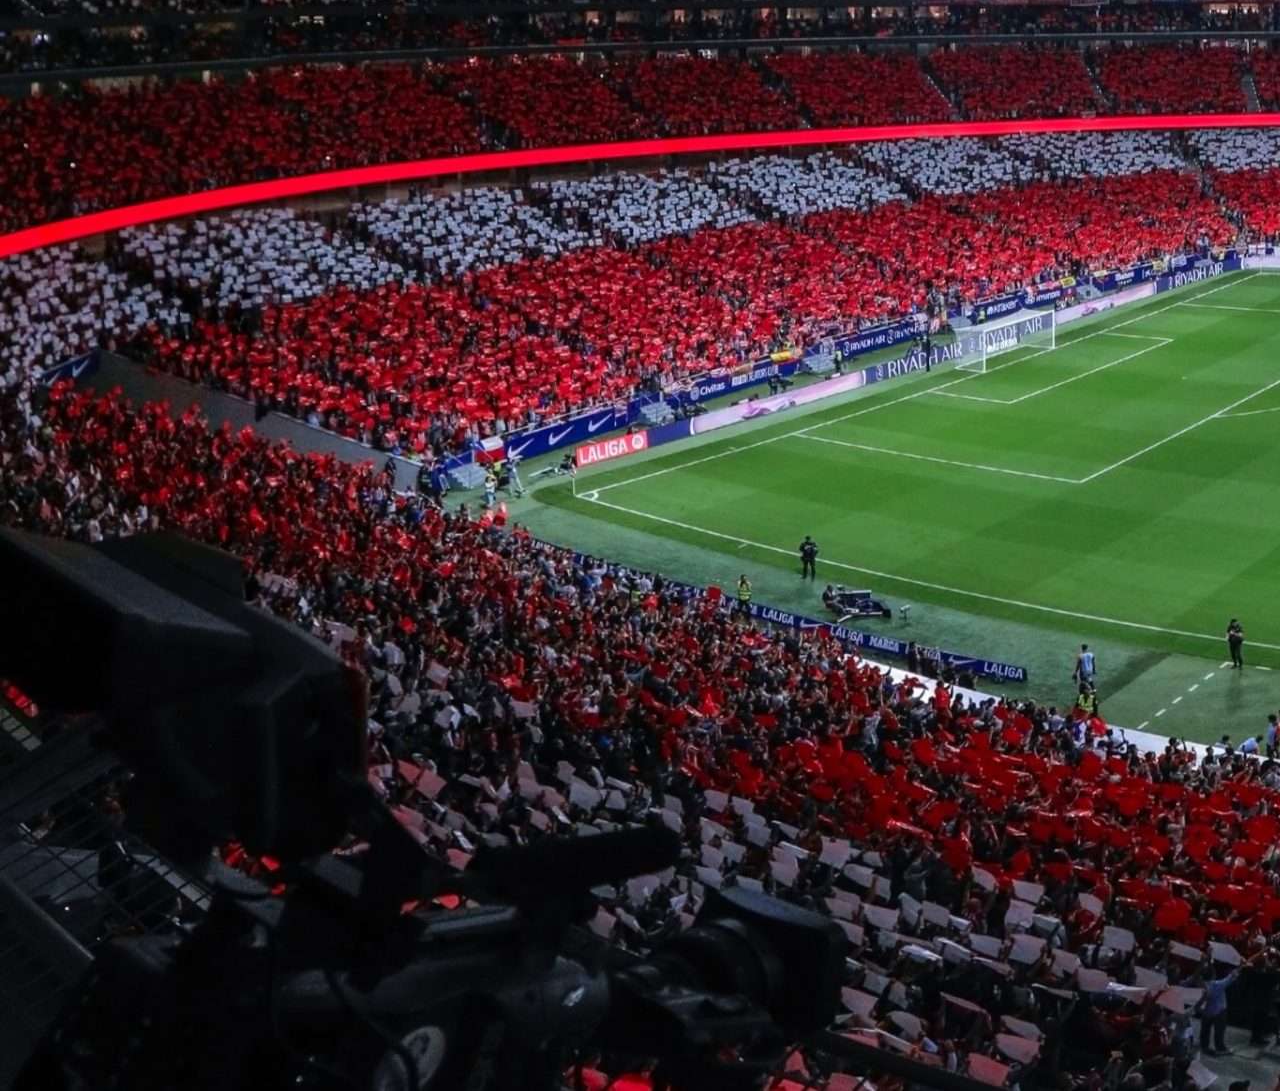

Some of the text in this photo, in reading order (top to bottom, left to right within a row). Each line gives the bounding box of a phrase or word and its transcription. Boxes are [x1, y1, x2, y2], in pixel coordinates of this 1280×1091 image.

[1175, 262, 1224, 287] RIYADH AIR
[1024, 317, 1043, 334] AIR
[941, 342, 962, 361] AIR
[580, 437, 629, 465] LALIGA
[762, 607, 794, 625] LALIGA
[830, 625, 863, 644] LALIGA
[869, 635, 900, 653] MARCA
[983, 661, 1024, 679] LALIGA
